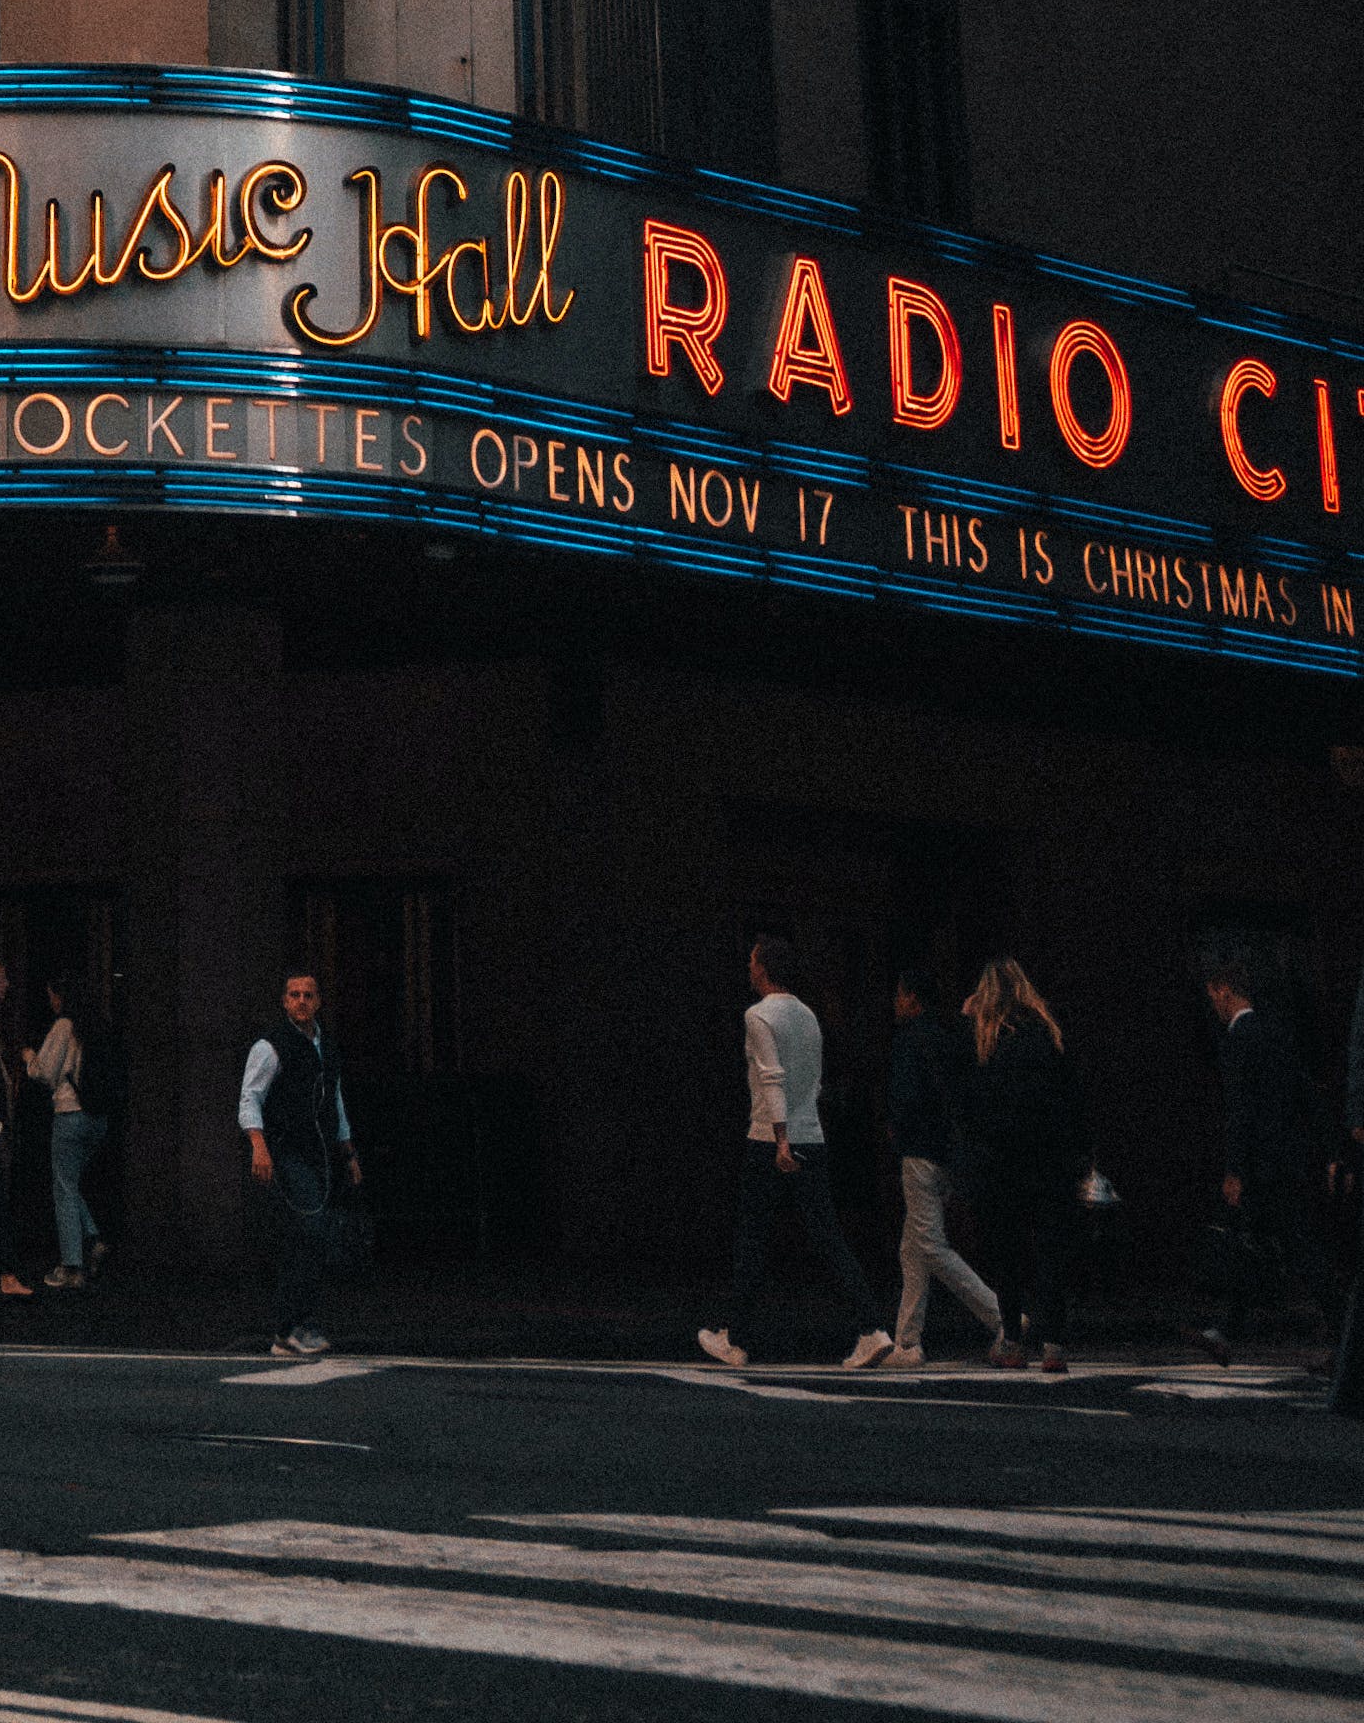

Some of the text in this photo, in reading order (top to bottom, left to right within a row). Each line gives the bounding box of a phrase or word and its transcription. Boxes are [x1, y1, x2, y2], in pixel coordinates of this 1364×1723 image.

[284, 161, 576, 347] Hall
[644, 217, 1364, 512] RADIO CI
[470, 428, 636, 513] OPENS
[669, 462, 760, 534] NOV
[798, 486, 834, 547] 17
[897, 504, 989, 574] THIS
[1019, 527, 1054, 586] IS
[1083, 541, 1298, 627] CHRISTMAS
[1321, 582, 1356, 638] IN
